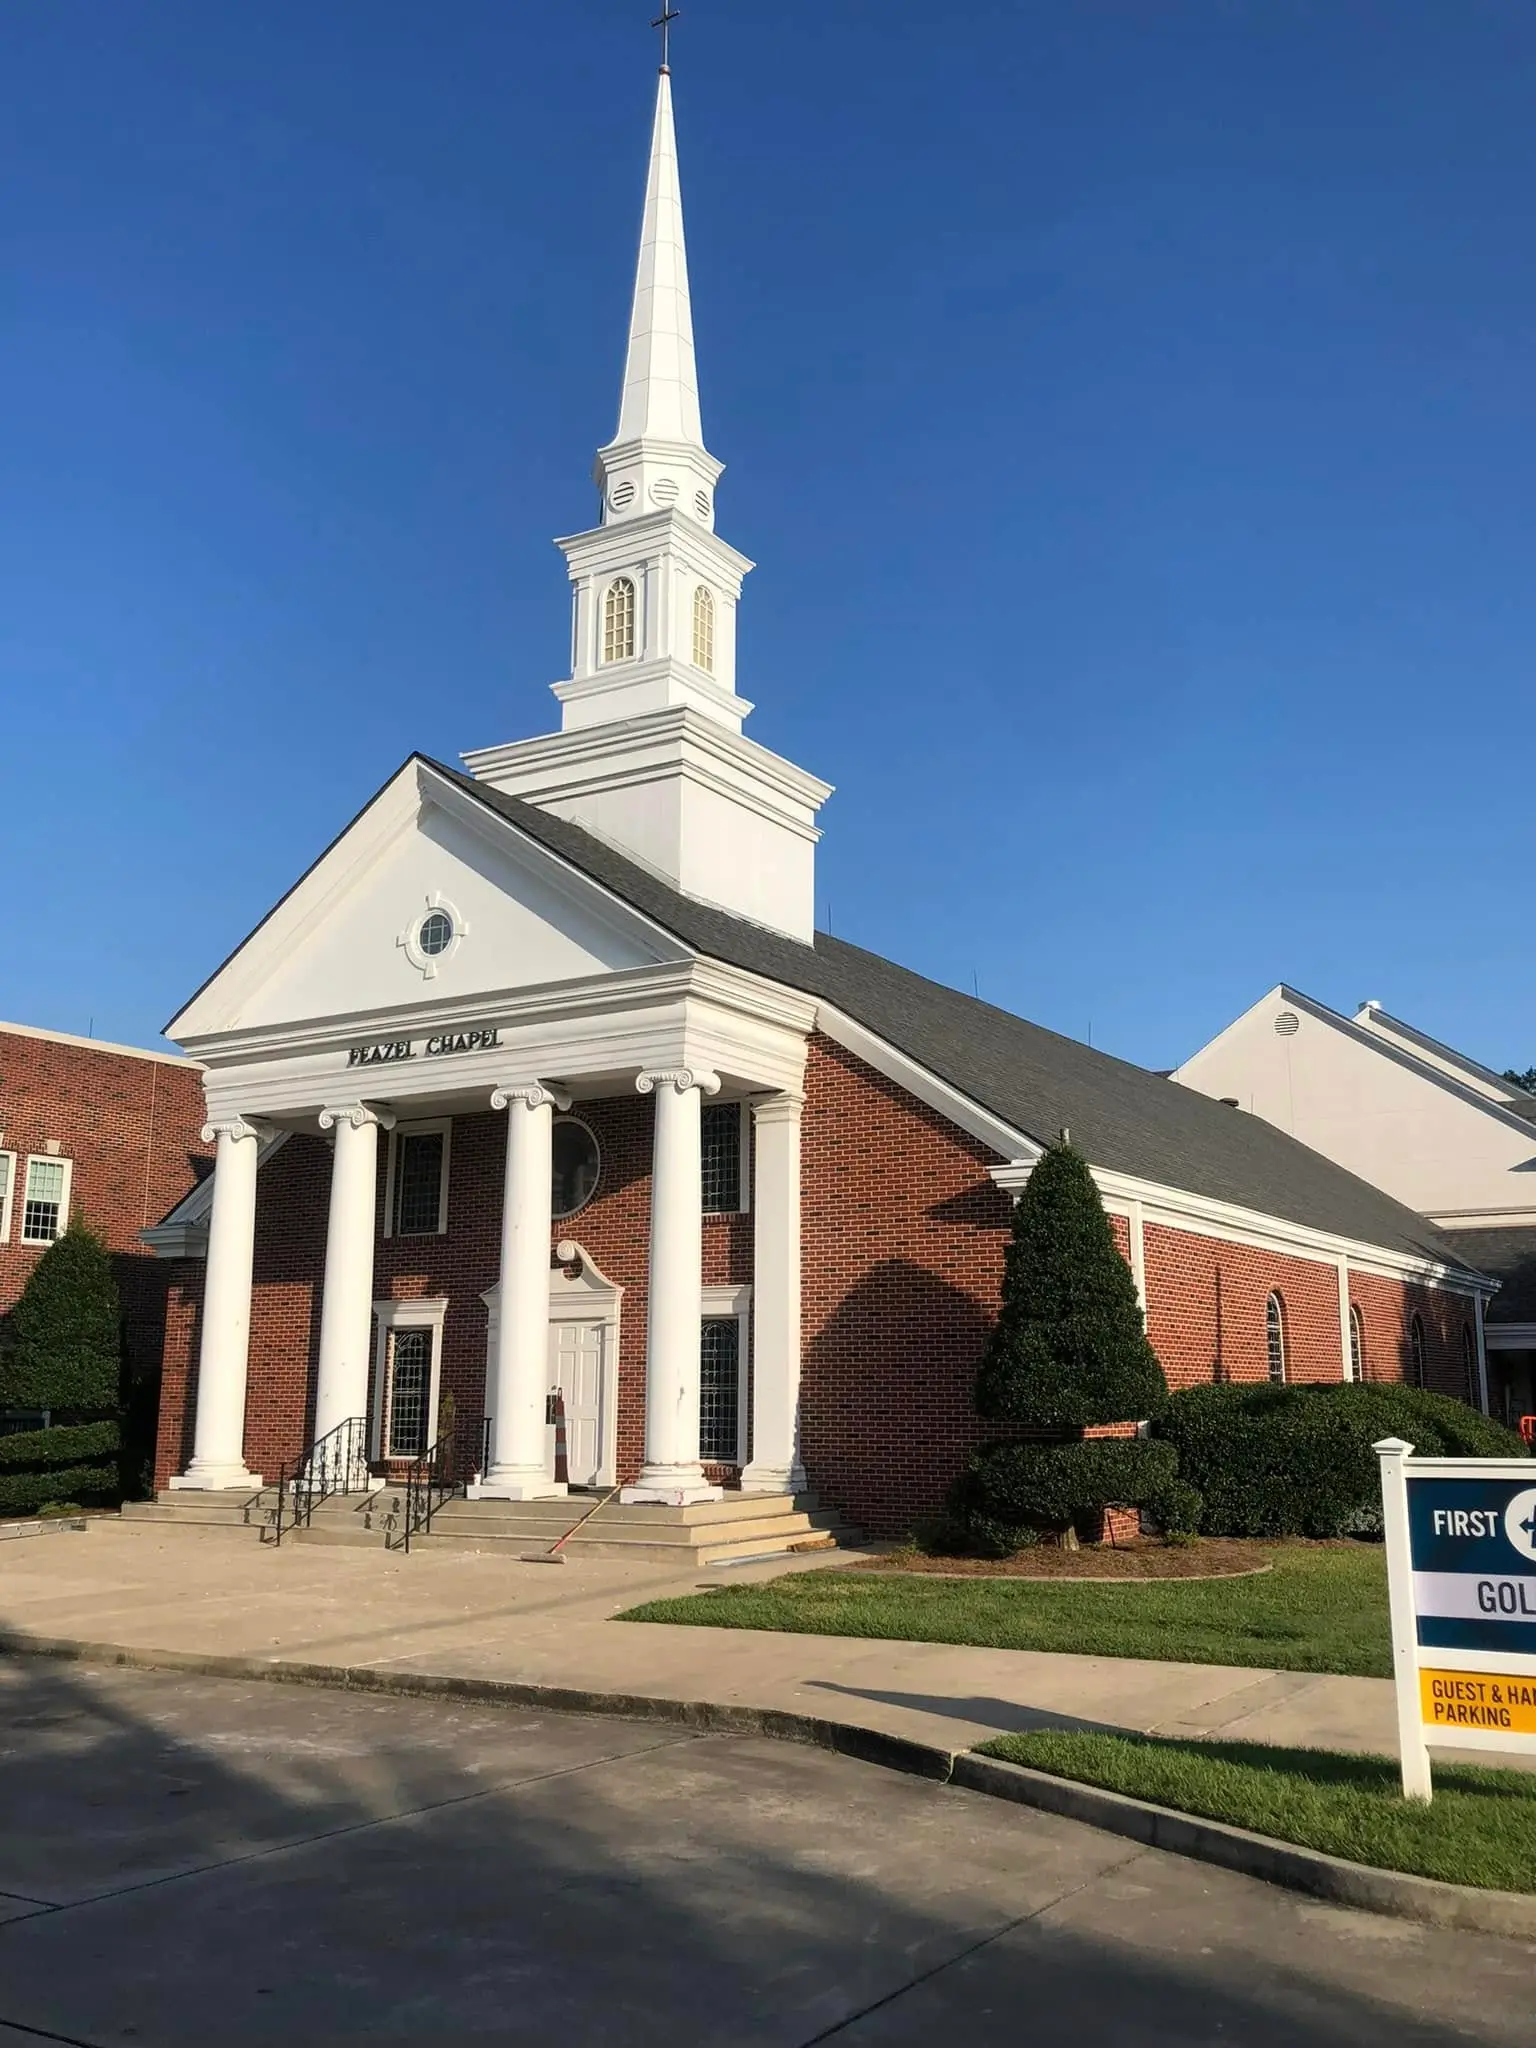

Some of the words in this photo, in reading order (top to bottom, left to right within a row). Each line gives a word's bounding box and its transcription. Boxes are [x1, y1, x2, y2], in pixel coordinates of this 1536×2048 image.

[349, 1040, 416, 1064] FEAZEL
[427, 1028, 503, 1055] CHAPEL
[1433, 1510, 1498, 1537] FIRST
[1432, 1679, 1485, 1702] GUEST
[1491, 1684, 1503, 1703] &
[1434, 1702, 1511, 1728] PARKING
